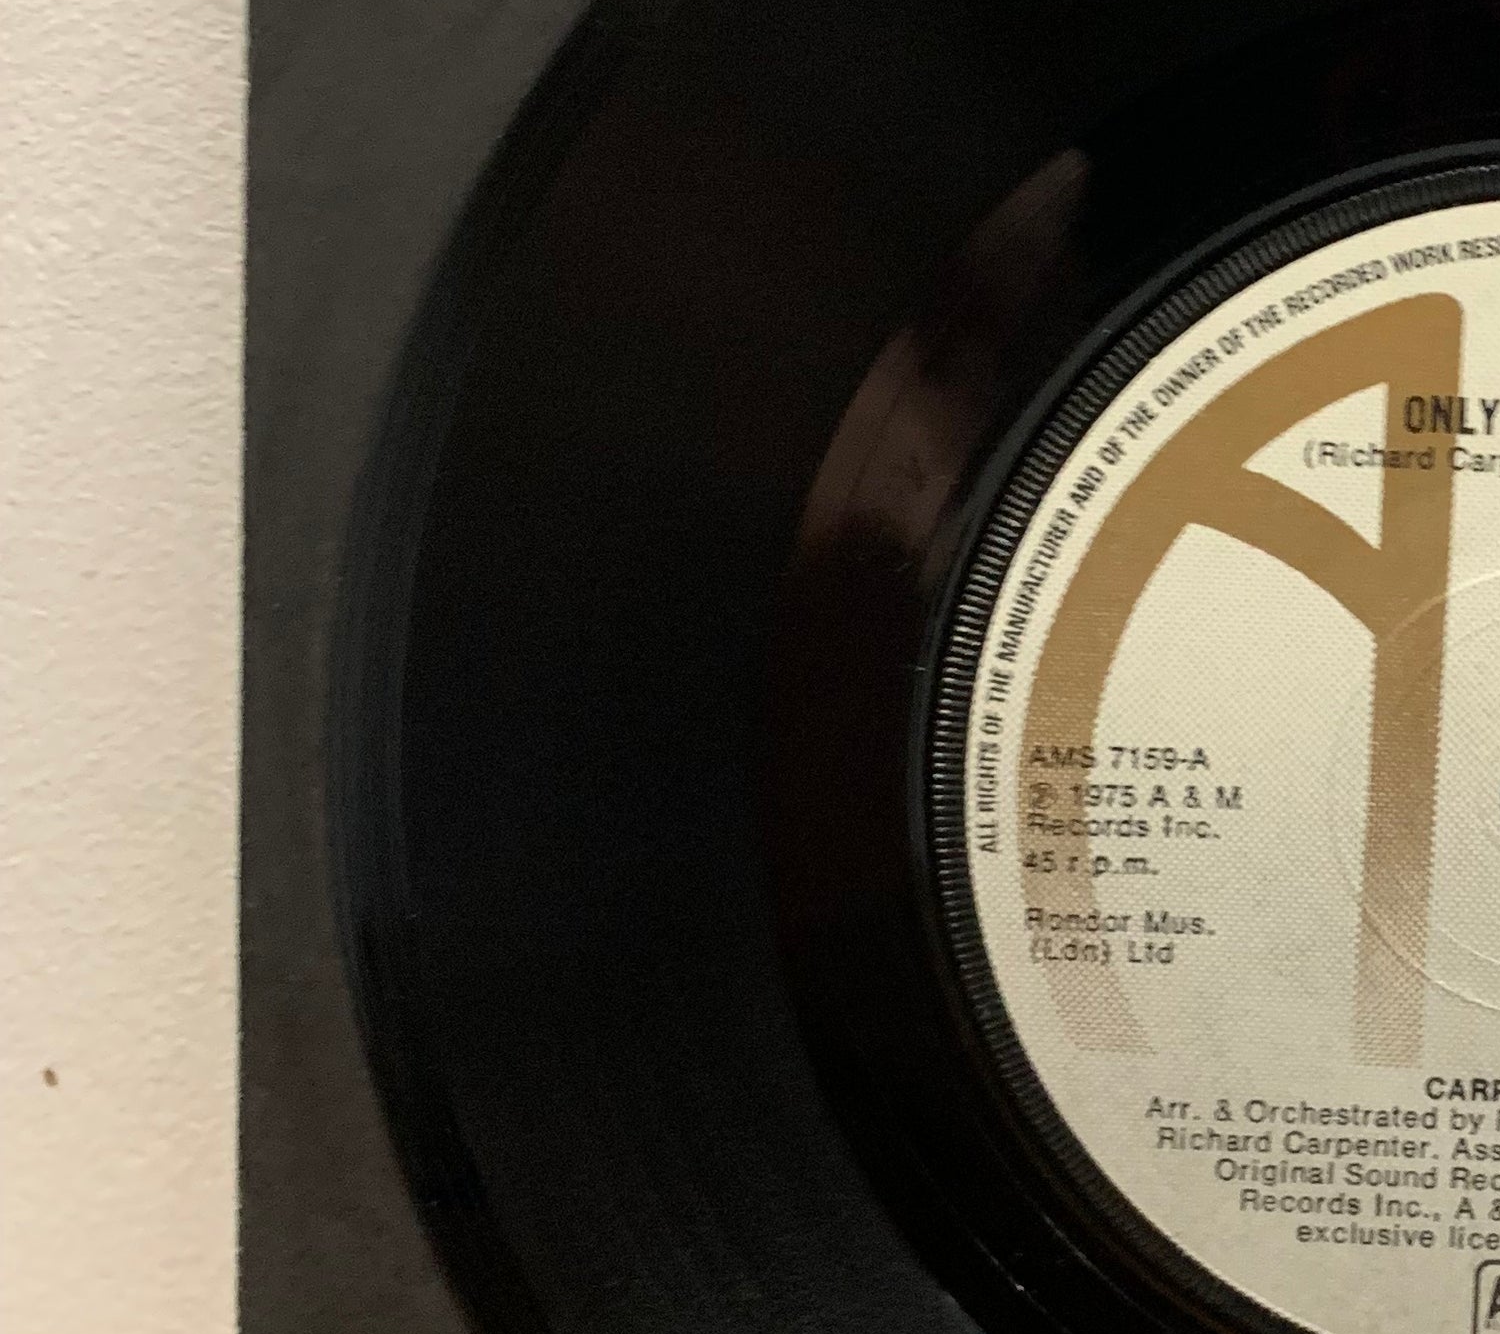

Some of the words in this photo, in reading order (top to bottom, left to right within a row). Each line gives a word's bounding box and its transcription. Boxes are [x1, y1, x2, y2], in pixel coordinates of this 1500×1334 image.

[1387, 242, 1455, 275] WORK
[1281, 258, 1390, 318] RECORDED
[1240, 303, 1285, 338] THE
[1216, 327, 1246, 356] OF
[1151, 347, 1223, 407] OWNER
[1117, 400, 1159, 441] THE
[1097, 435, 1127, 466] OF
[1303, 440, 1436, 471] (Richard
[1067, 465, 1107, 510] AND
[995, 507, 1079, 665] MANUFACTURER
[988, 668, 1014, 704] THE
[980, 714, 1003, 737] OF
[1029, 745, 1097, 770] AMS
[1107, 746, 1211, 771] 7159-A
[976, 741, 1000, 813] RIGHTS
[1068, 784, 1138, 809] 1975
[1148, 784, 1171, 809] A
[1182, 785, 1203, 809] &
[1214, 785, 1244, 810] M
[978, 824, 999, 854] ALL
[1026, 812, 1150, 838] Records
[1161, 815, 1222, 839] Inc.
[1022, 850, 1058, 874] 45
[1025, 906, 1133, 932] Rondor
[1142, 909, 1217, 936] Mus.
[1029, 939, 1112, 966] (Ldn)
[1126, 939, 1175, 964] Ltd
[1145, 1095, 1202, 1122] Arr.
[1213, 1098, 1235, 1123] &
[1245, 1099, 1440, 1130] Orchestrated
[1449, 1107, 1487, 1136] by
[1156, 1126, 1273, 1155] Richard
[1214, 1157, 1335, 1187] Original
[1343, 1163, 1439, 1190] Sound
[1238, 1187, 1363, 1216] Records
[1453, 1197, 1477, 1222] A
[1296, 1222, 1437, 1249] exclusive
